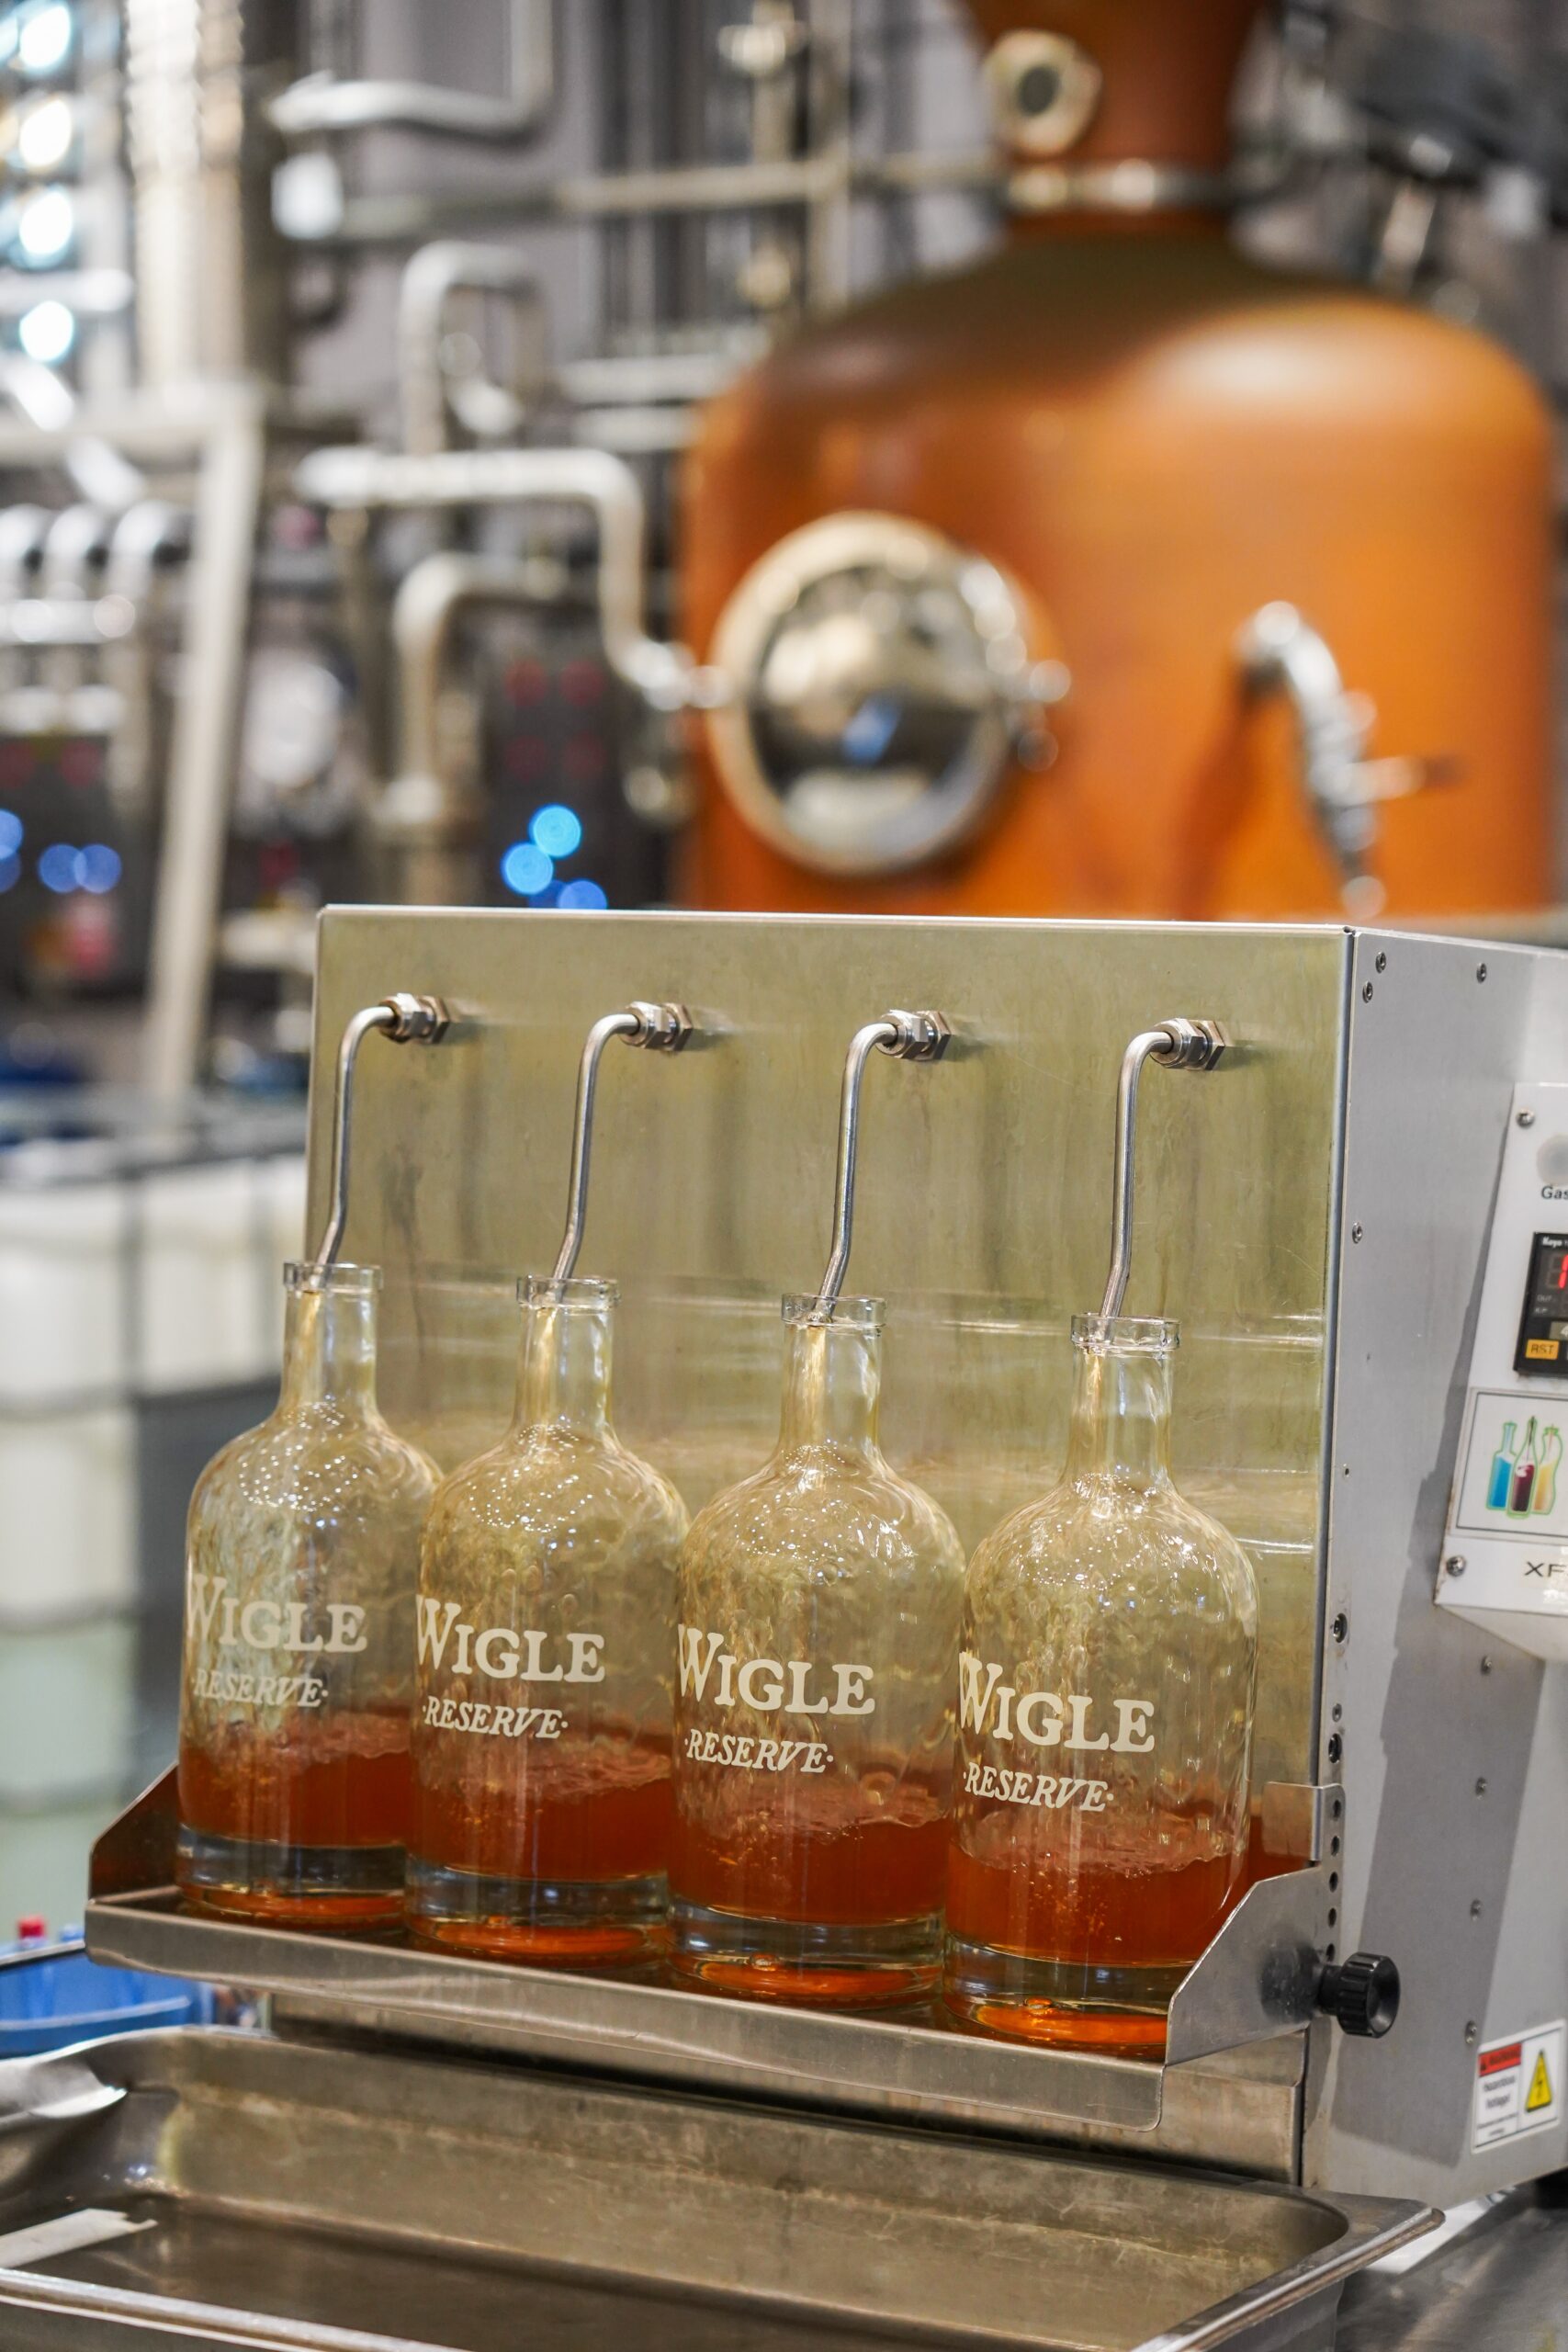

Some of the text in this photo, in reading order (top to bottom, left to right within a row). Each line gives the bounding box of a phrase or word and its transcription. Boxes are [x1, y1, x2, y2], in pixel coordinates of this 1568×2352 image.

[1531, 1343, 1554, 1354] RST
[186, 1573, 367, 1653] WIGLE
[416, 1594, 606, 1683] WIGLE
[678, 1623, 876, 1715] WIGLE
[959, 1651, 1156, 1753] WIGLE
